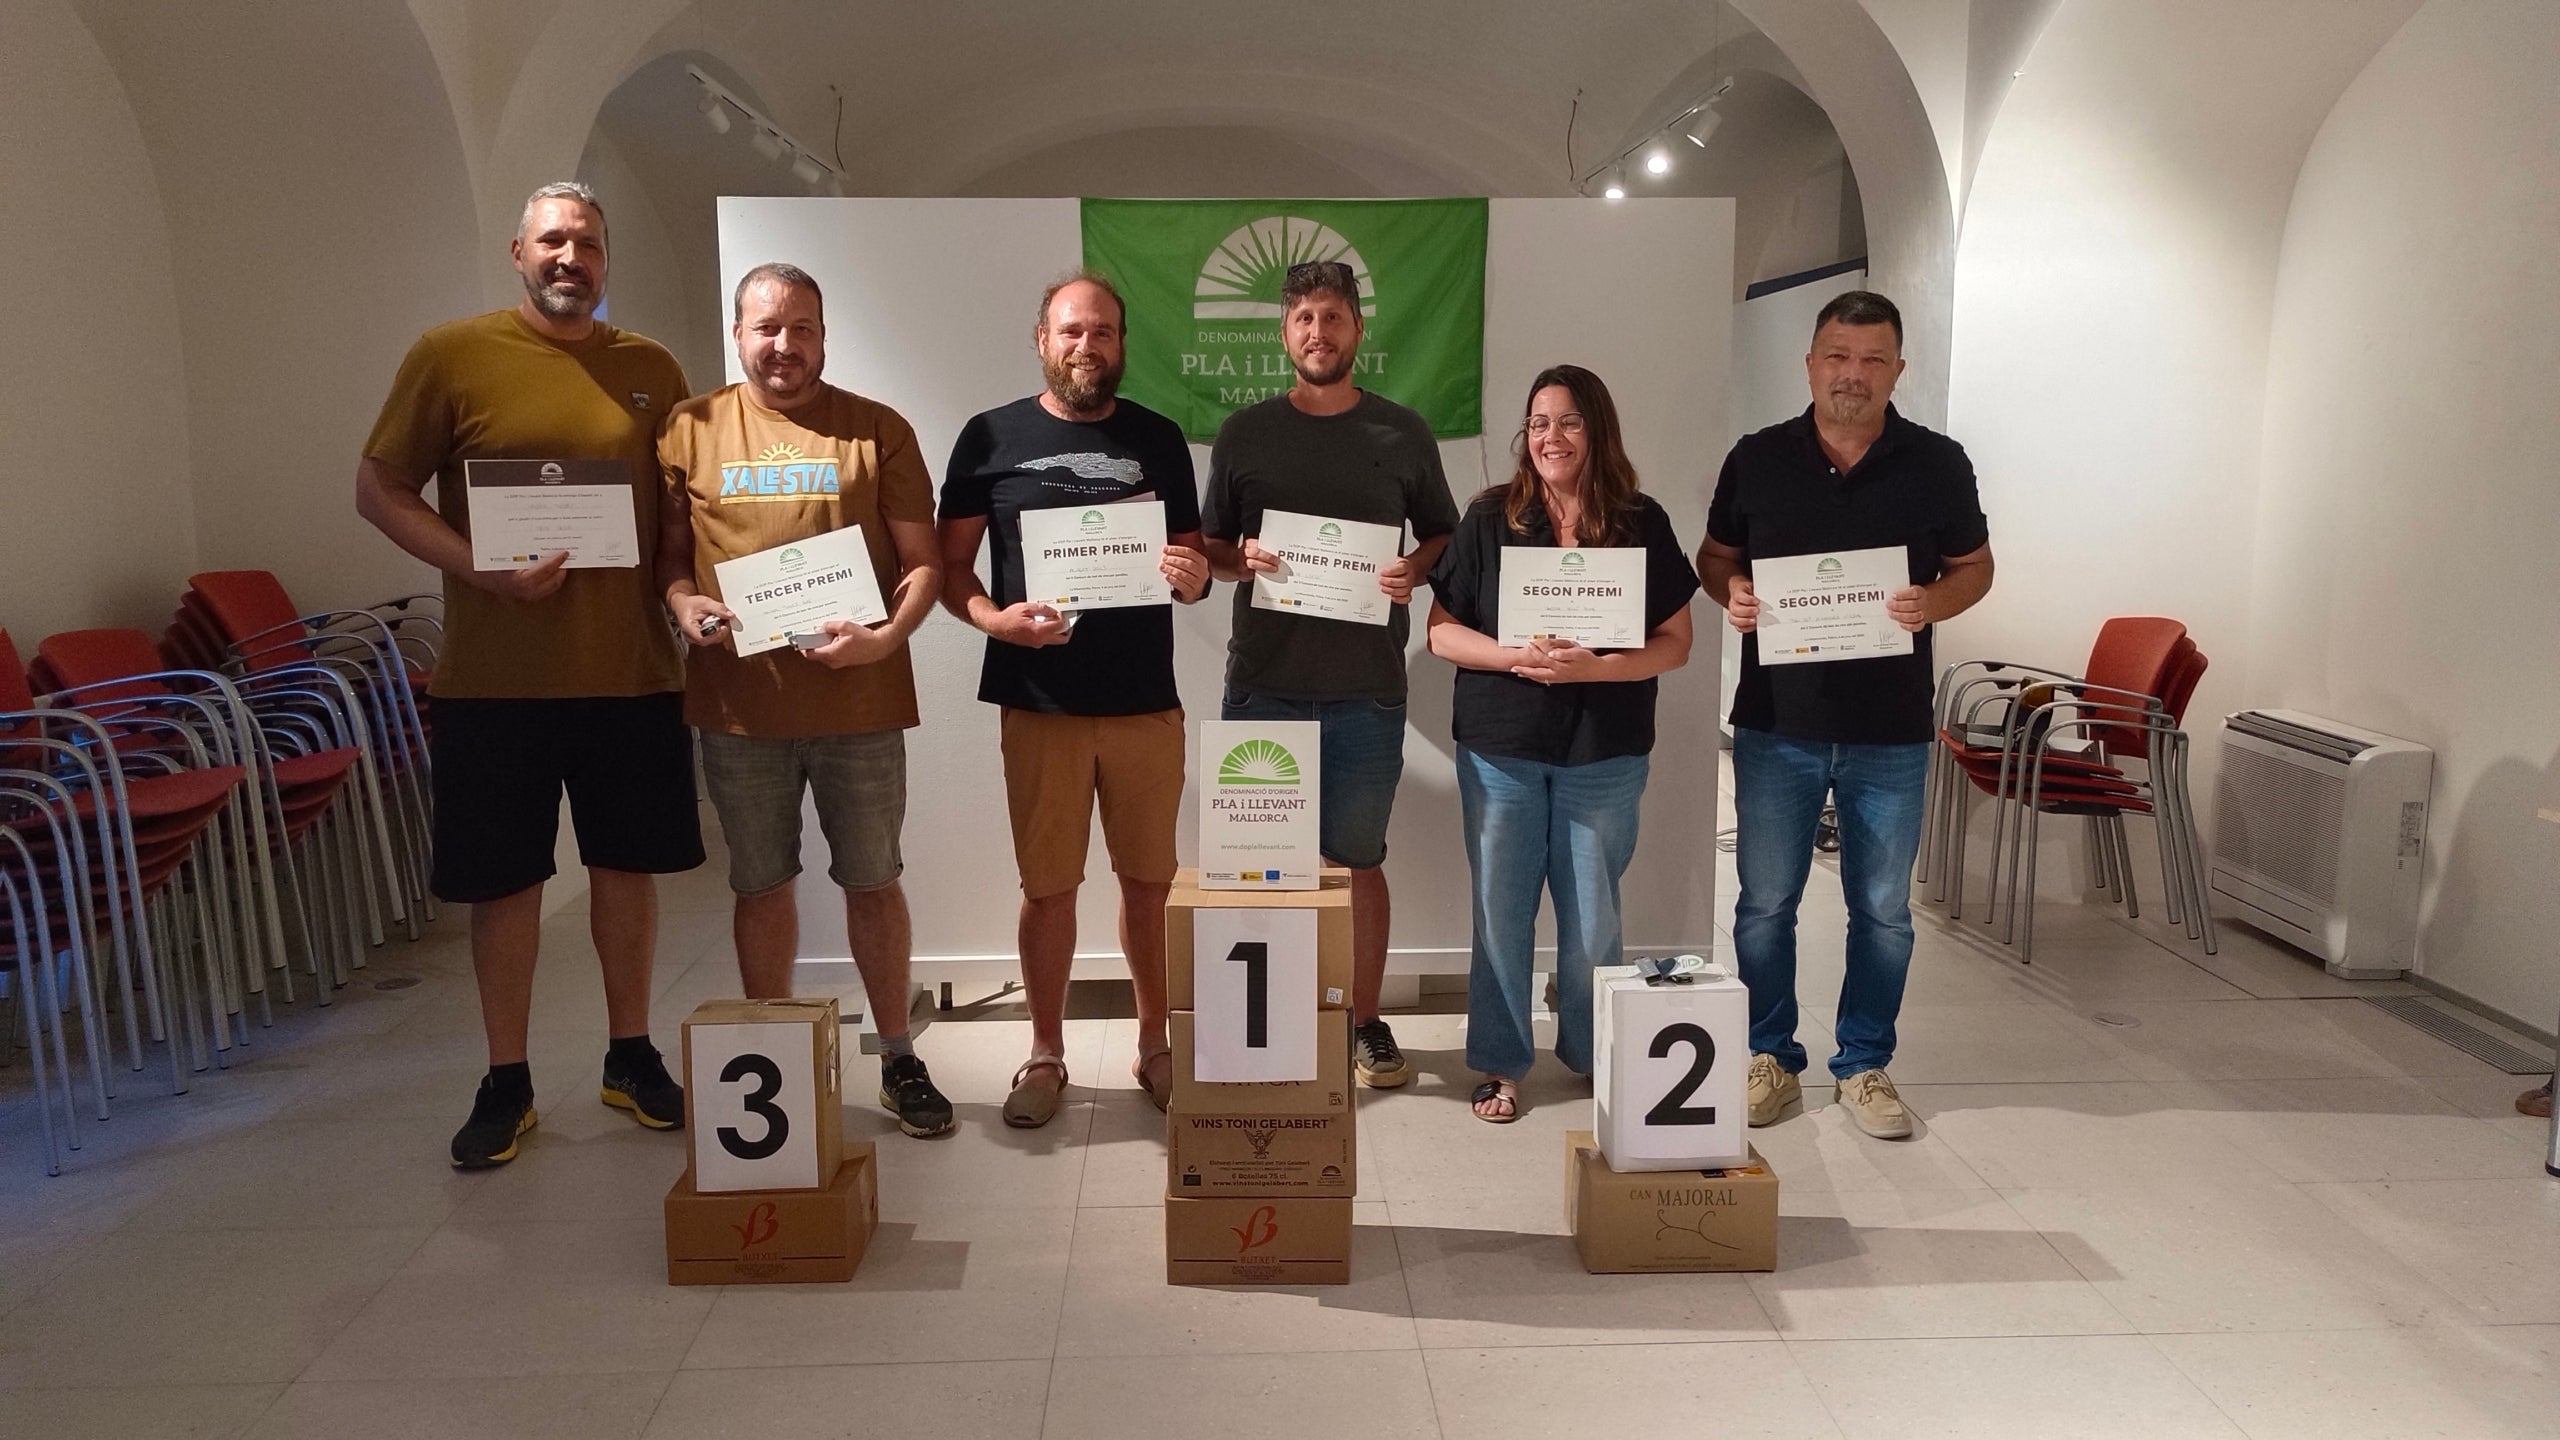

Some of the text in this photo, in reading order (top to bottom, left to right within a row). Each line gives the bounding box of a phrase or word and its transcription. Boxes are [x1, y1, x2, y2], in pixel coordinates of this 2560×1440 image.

[1198, 331, 1283, 343] DENOMINAC
[1181, 352, 1389, 376] PLA i LLNT
[720, 464, 840, 496] XALESTIA
[1044, 543, 1147, 560] PRIMER PREMI
[1278, 550, 1329, 567] PRIMER
[1333, 558, 1376, 574] PREMI
[745, 568, 853, 605] TERCER PREMI
[1522, 586, 1622, 597] SEGON PREMI
[1779, 590, 1885, 609] SEGON PREMI
[1212, 799, 1306, 810] PLA i LLEVANT
[1229, 813, 1289, 822] MALLORCA
[1225, 942, 1268, 1048] 1
[1644, 1022, 1716, 1126] 2
[716, 1053, 790, 1160] 3
[1191, 1119, 1329, 1129] VINS TONI GELABERT
[1630, 1188, 1738, 1206] CAN MAJORAL
